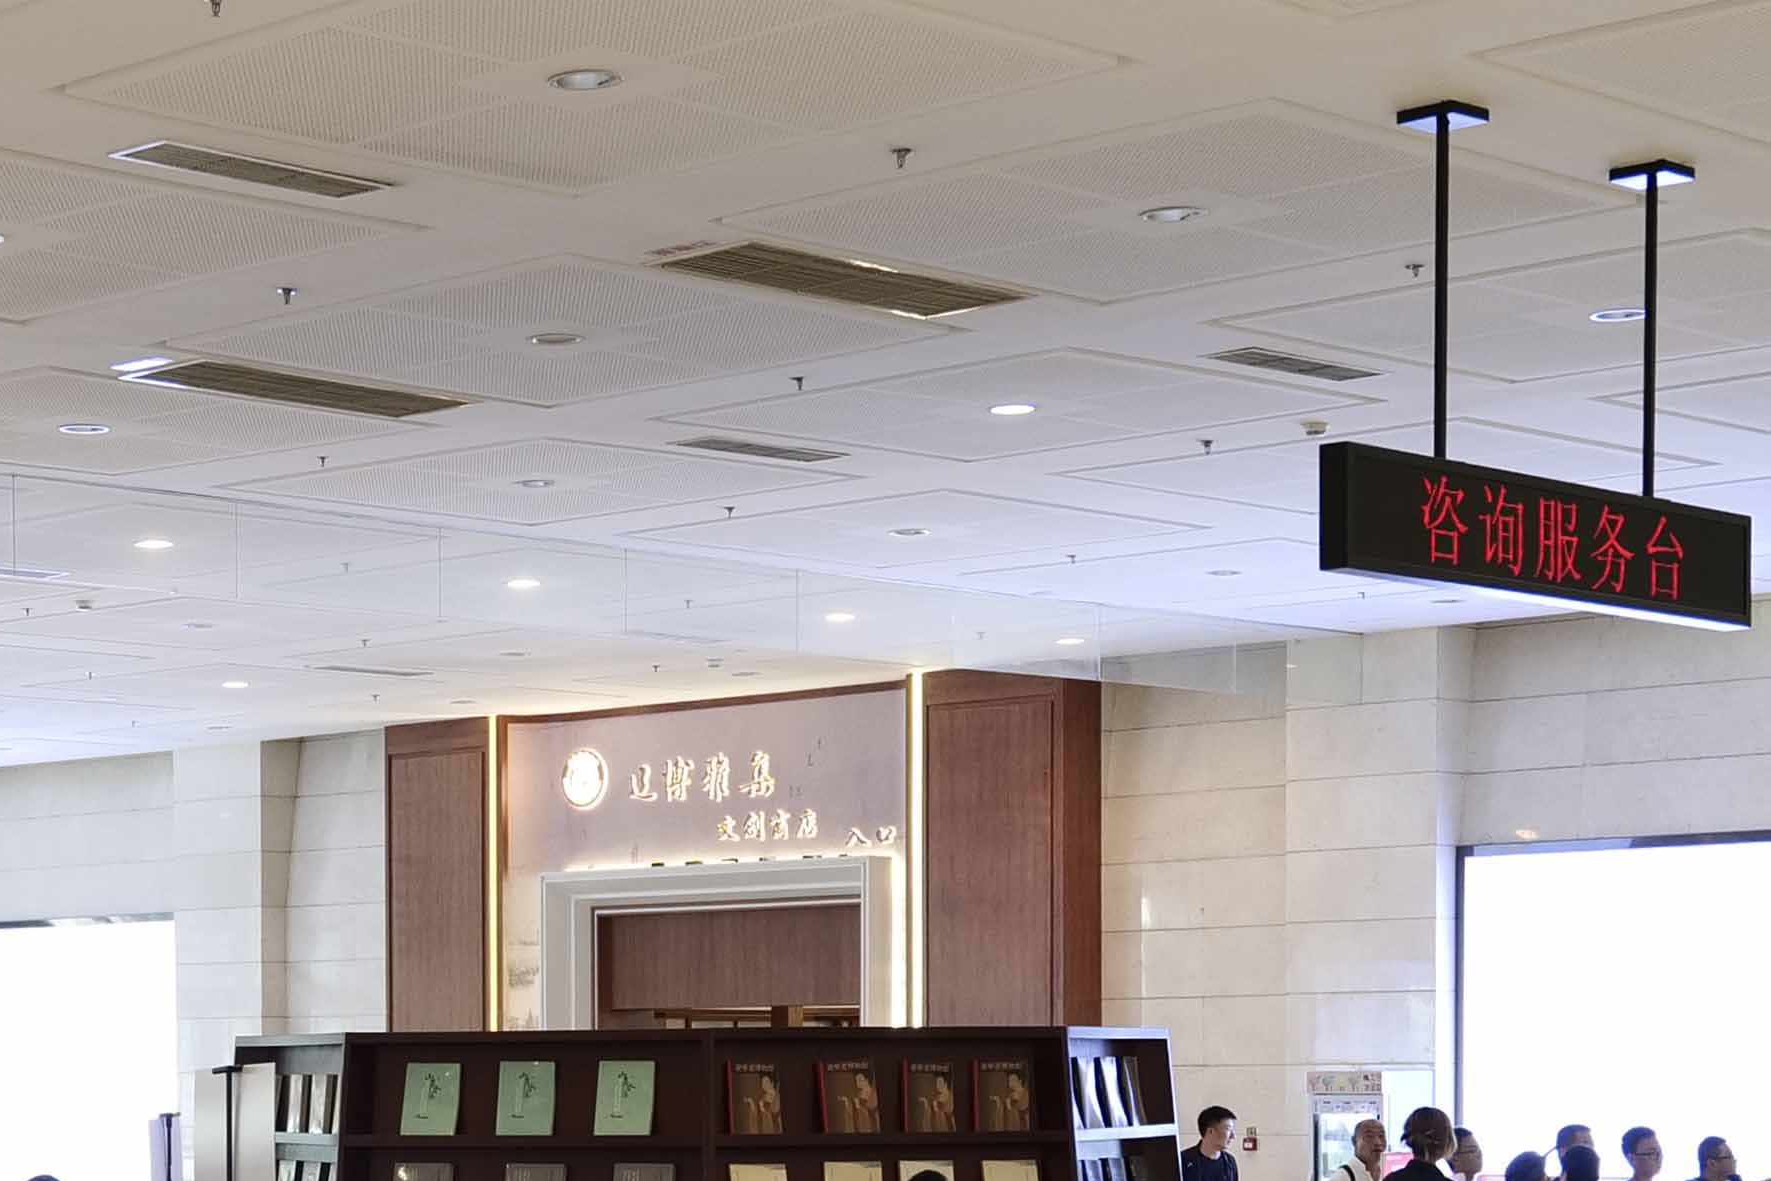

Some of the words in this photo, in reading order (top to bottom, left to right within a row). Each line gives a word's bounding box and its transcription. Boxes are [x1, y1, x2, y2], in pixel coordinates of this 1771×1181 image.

[1421, 474, 1685, 600] 咨询服务台
[716, 808, 819, 842] 文创商店
[845, 825, 898, 848] 入口
